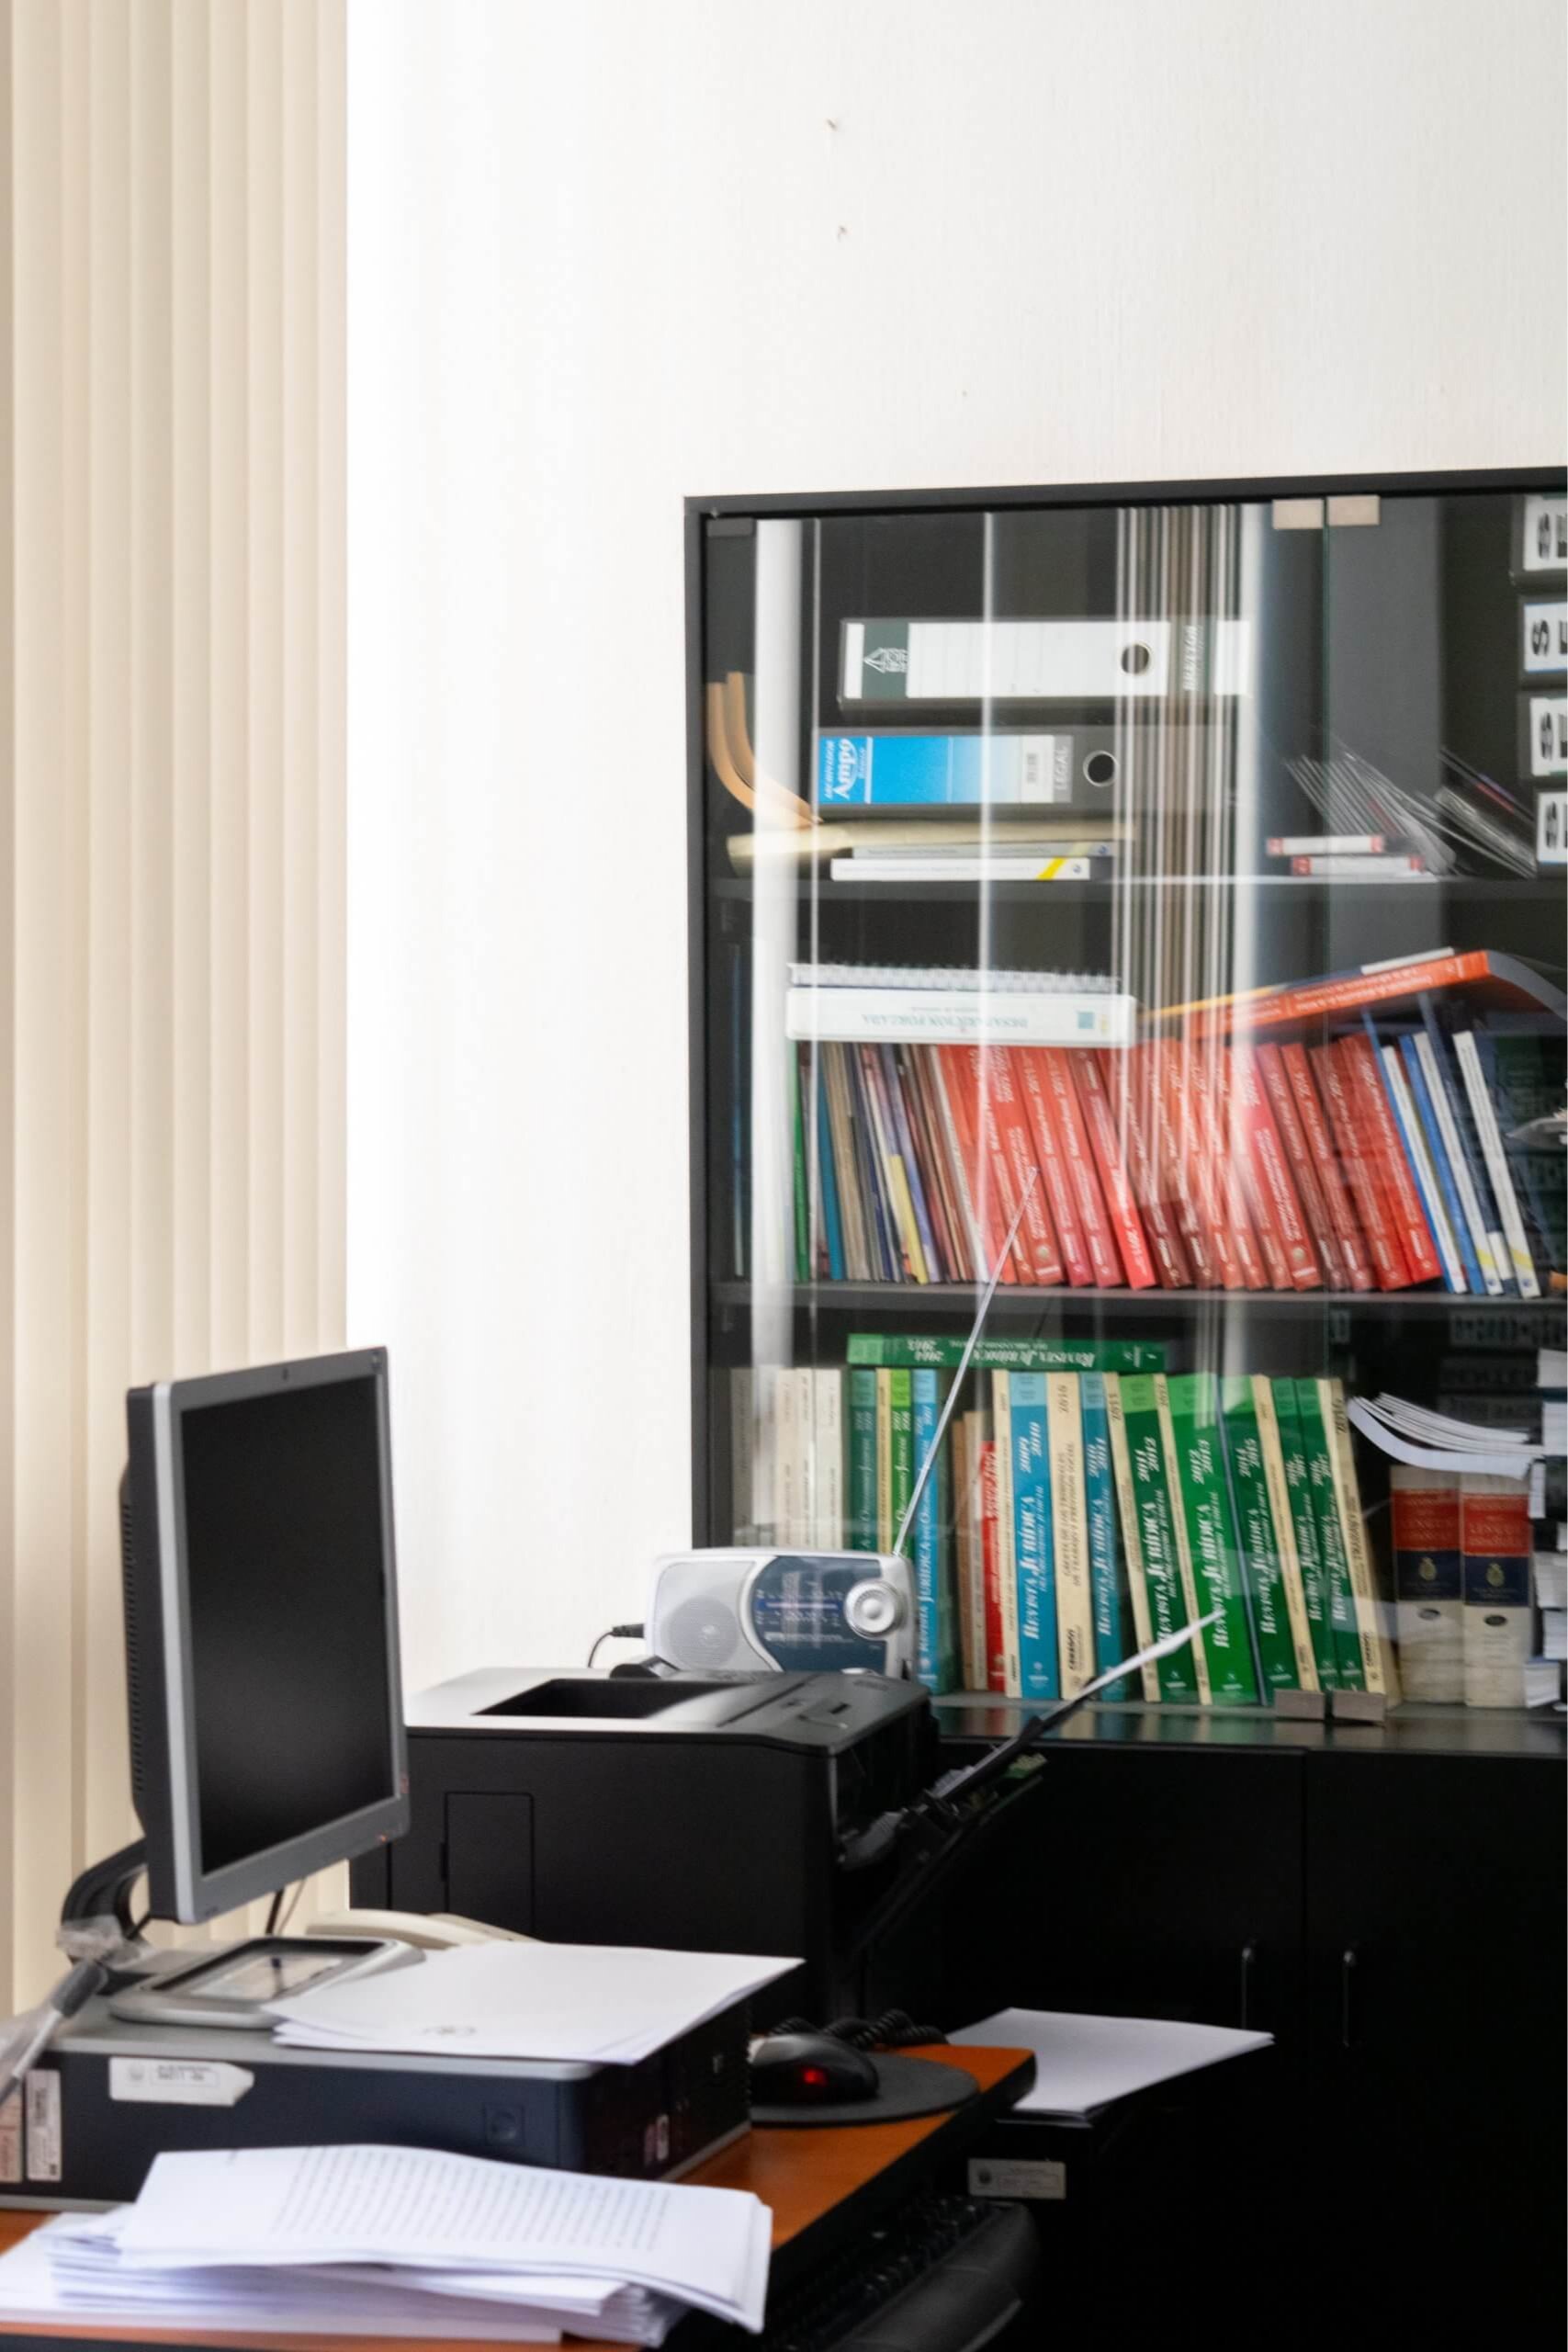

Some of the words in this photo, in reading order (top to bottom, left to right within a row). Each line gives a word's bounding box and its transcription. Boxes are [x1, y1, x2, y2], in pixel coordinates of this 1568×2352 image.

[833, 739, 856, 800] Ampo
[1134, 1448, 1150, 1482] 2011
[1144, 1436, 1159, 1472] 2012
[1019, 1495, 1041, 1576] JURÍDICA
[1142, 1502, 1168, 1582] JURÍDICA
[1196, 1504, 1224, 1585] JURÍDICA
[1022, 1577, 1040, 1639] REVISTA
[1210, 1586, 1230, 1648] REVSTA
